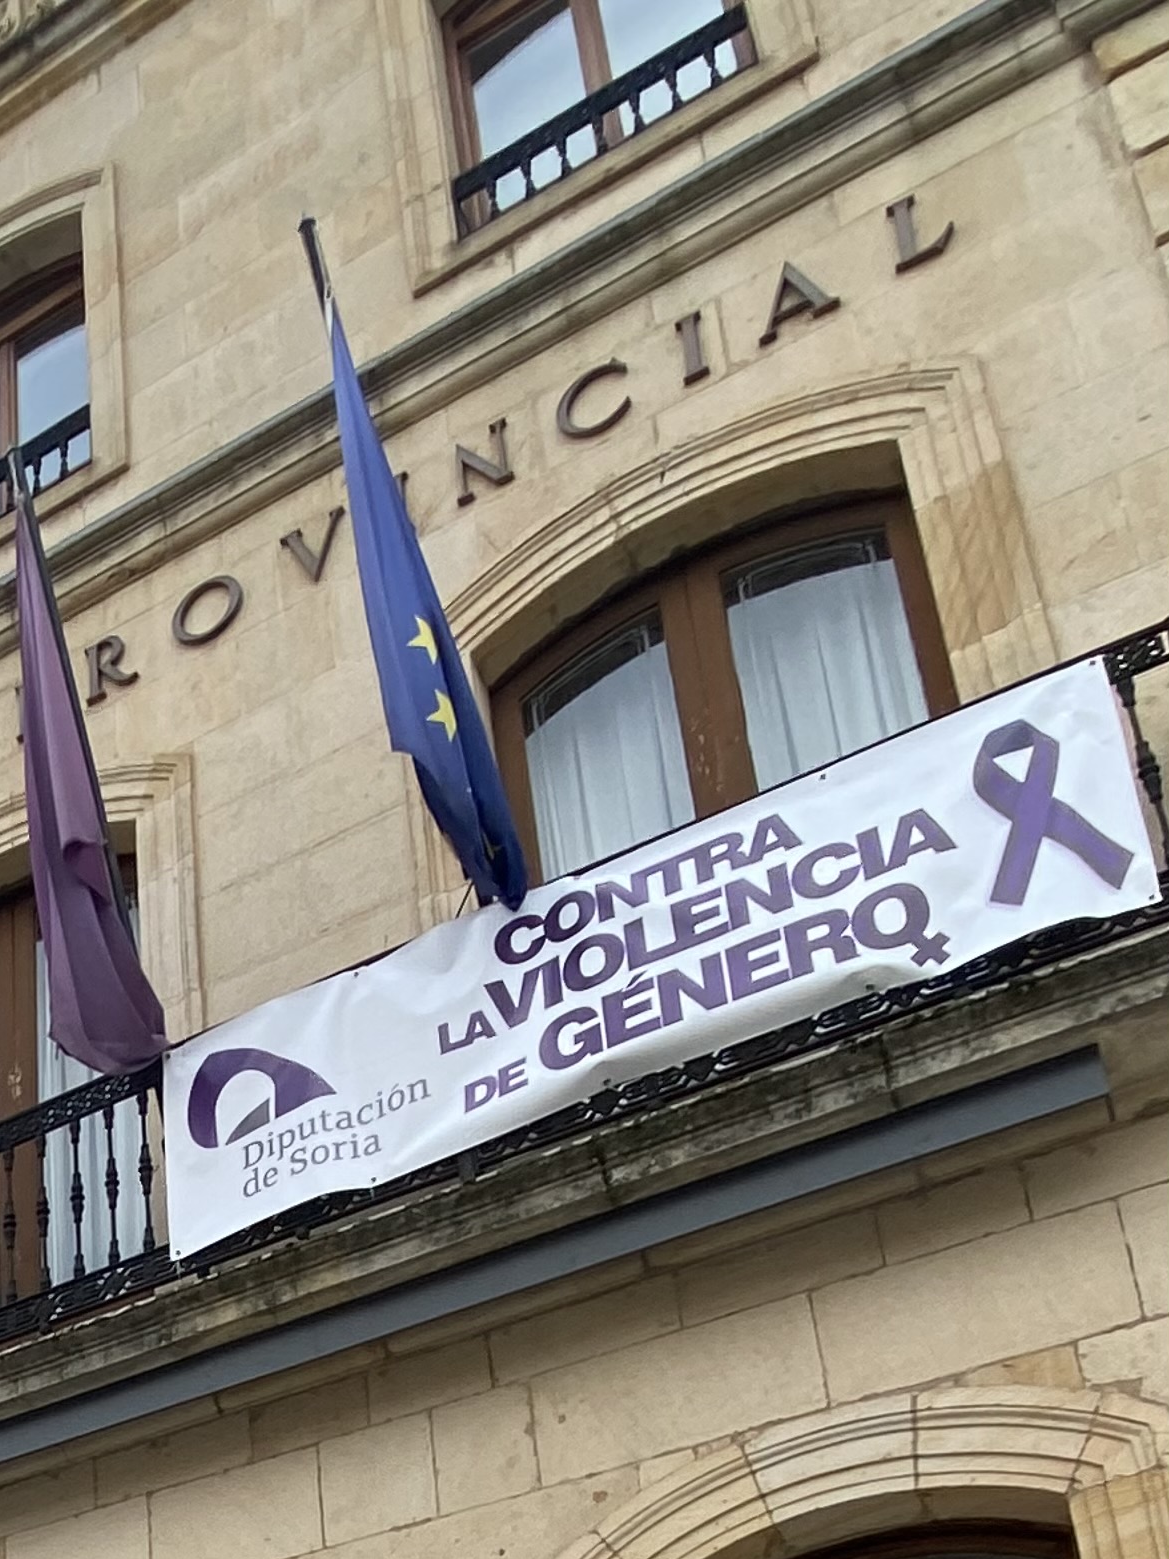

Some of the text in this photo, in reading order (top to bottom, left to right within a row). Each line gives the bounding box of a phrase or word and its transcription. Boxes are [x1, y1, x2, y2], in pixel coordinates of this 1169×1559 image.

[15, 193, 955, 744] ROVNCIAL
[437, 808, 957, 1056] LA VIOLENCIA
[493, 813, 804, 966] CONTRA
[463, 882, 951, 1114] DE GÉNERO
[241, 1076, 432, 1170] Diputación
[242, 1131, 383, 1201] de Soria
